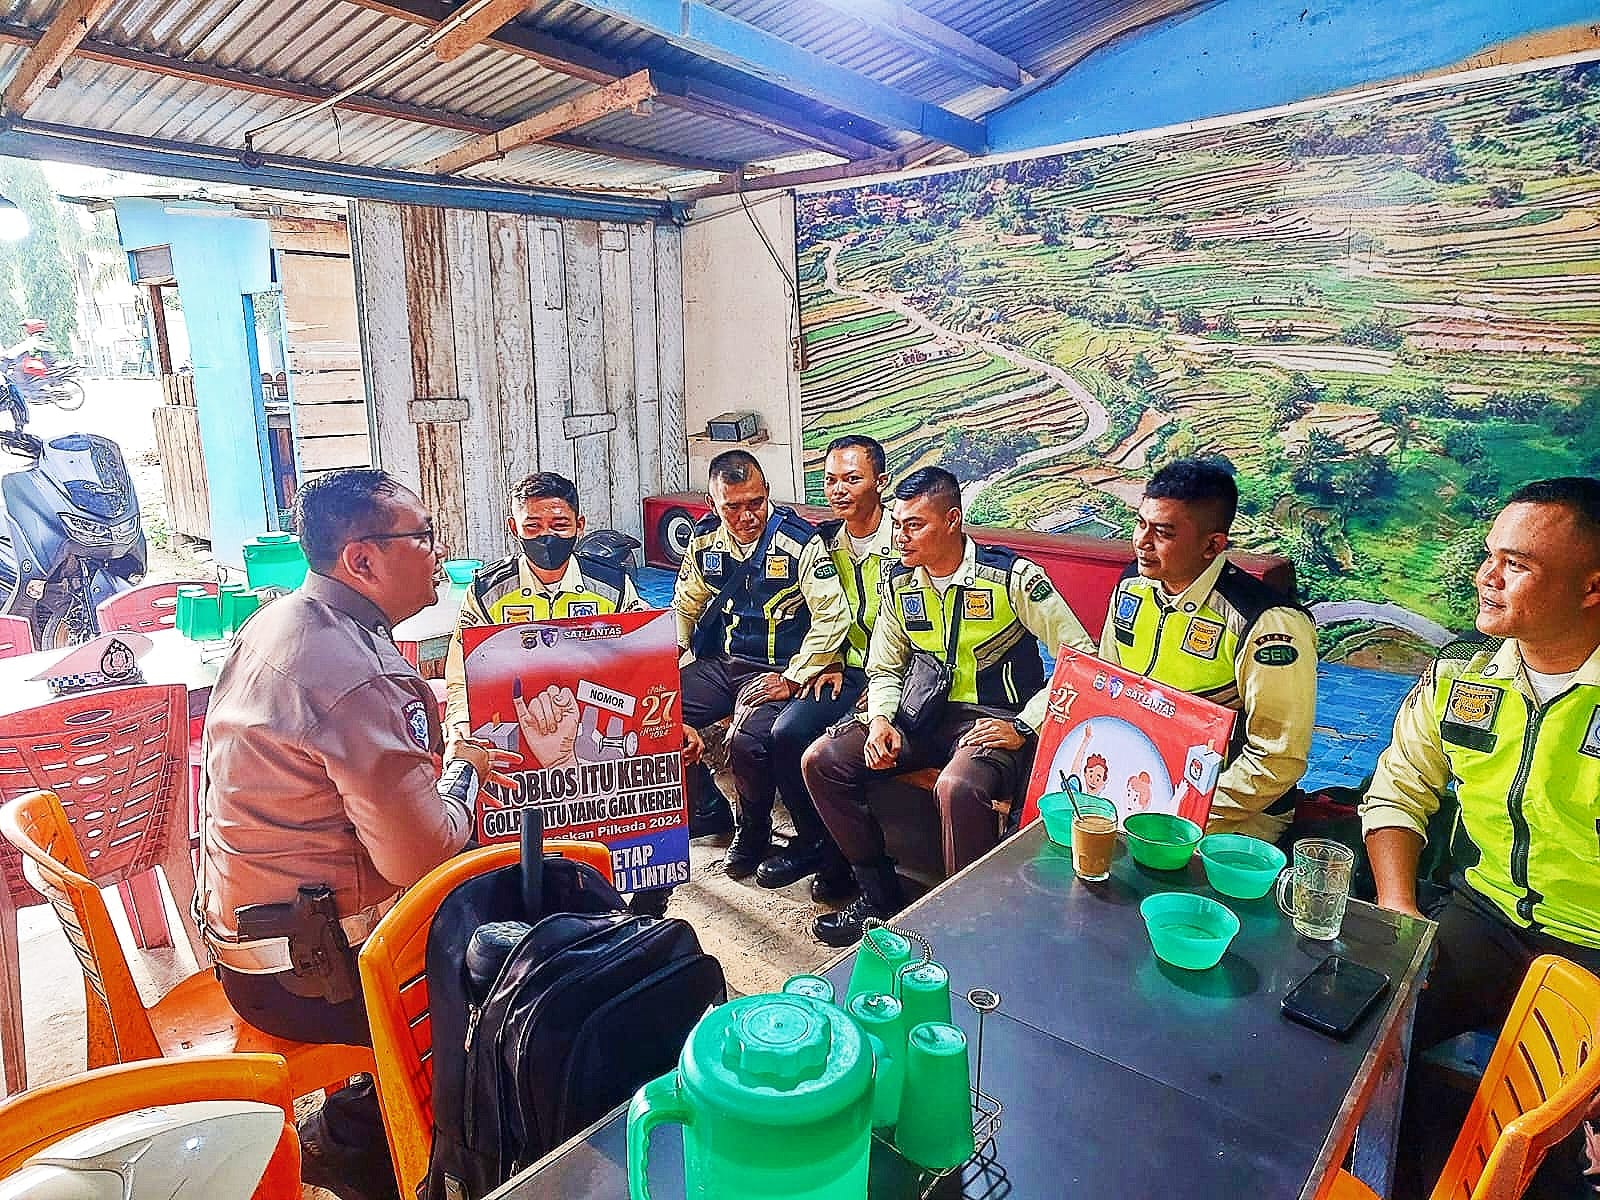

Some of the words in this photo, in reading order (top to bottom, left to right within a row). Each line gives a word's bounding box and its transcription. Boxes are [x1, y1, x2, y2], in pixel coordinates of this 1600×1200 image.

[590, 689, 624, 709] NOMOR
[641, 690, 677, 726] 27
[1054, 687, 1079, 714] 27
[580, 762, 616, 795] ITU
[617, 753, 680, 790] KEREN
[485, 810, 521, 835] GOLP
[543, 803, 567, 828] ITU
[568, 798, 606, 823] YANG
[607, 796, 637, 819] GAK
[638, 786, 682, 813] KEREN
[597, 821, 647, 838] Pilkada
[648, 813, 682, 829] 2024
[611, 844, 654, 870] ETAP
[632, 861, 689, 891] LINTAS
